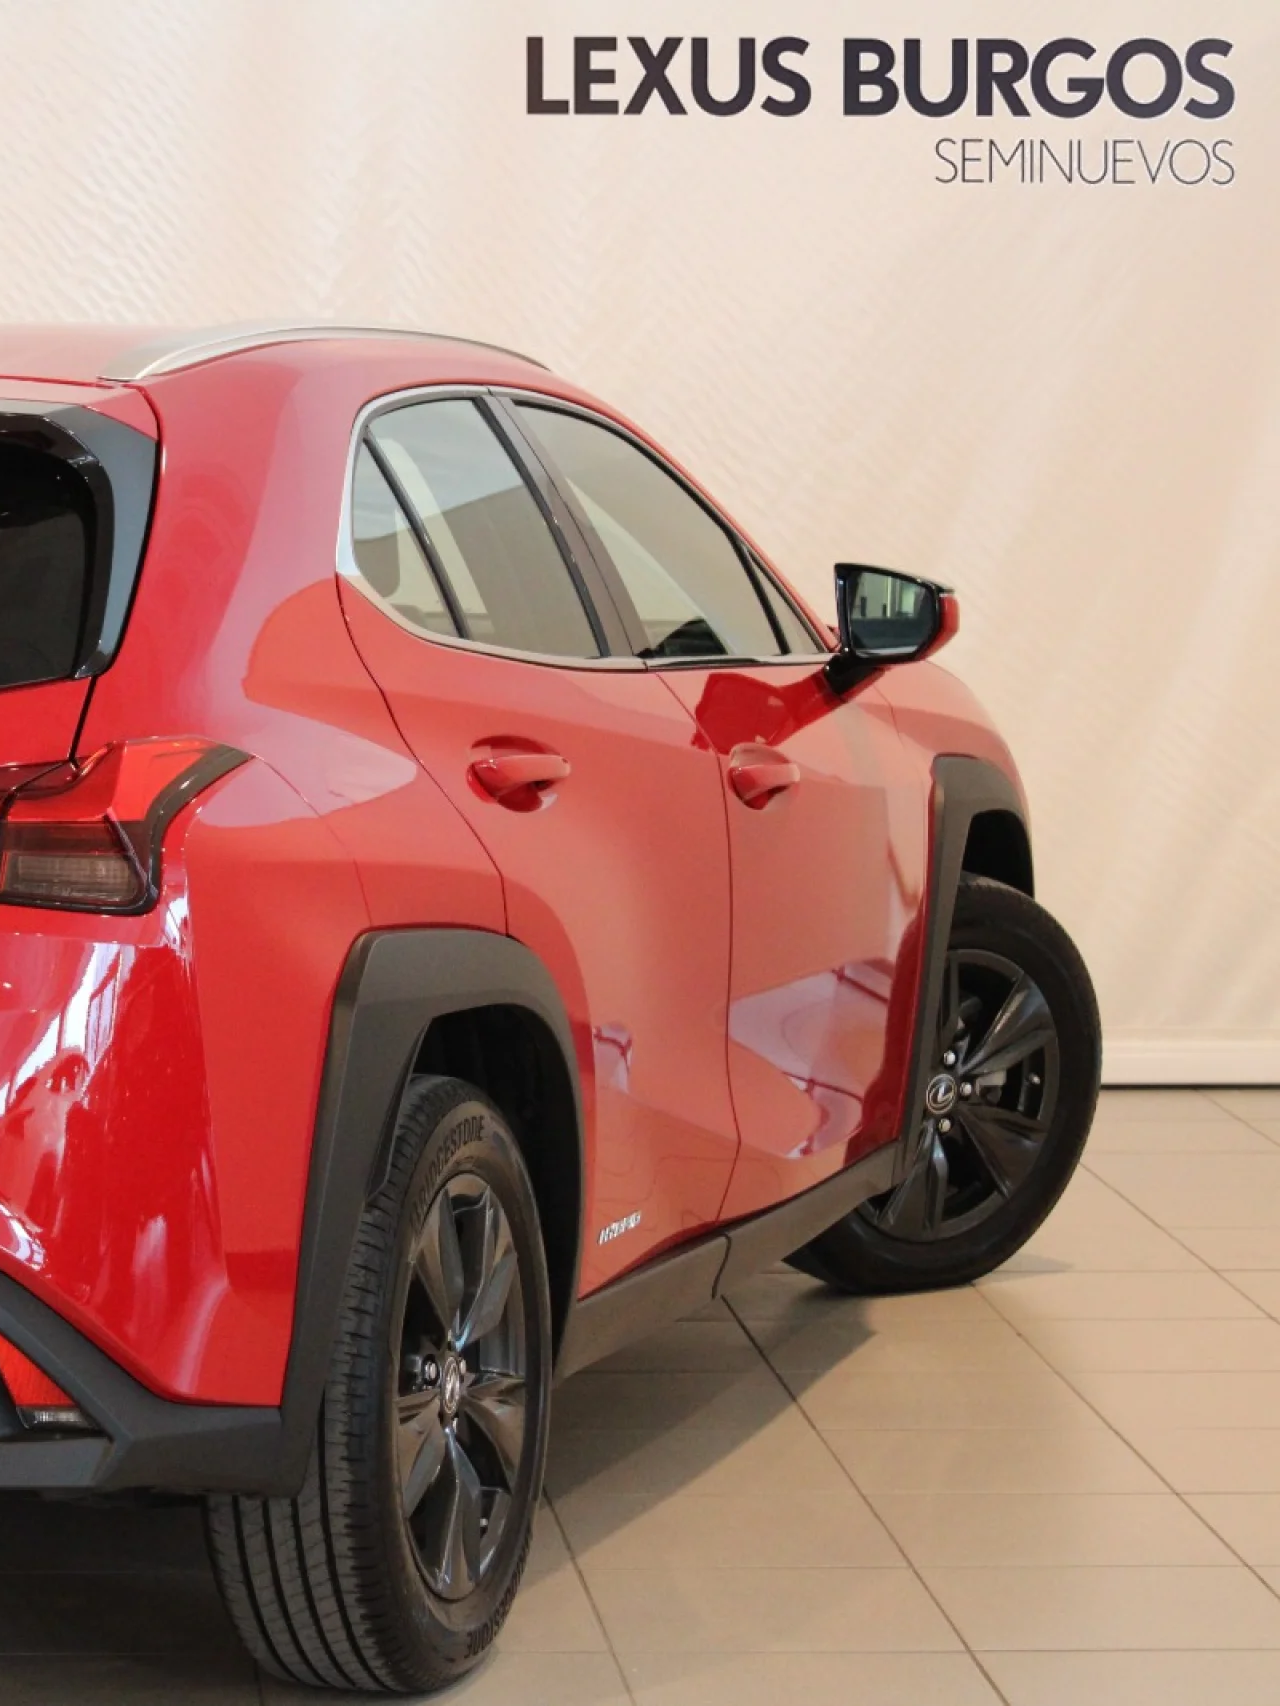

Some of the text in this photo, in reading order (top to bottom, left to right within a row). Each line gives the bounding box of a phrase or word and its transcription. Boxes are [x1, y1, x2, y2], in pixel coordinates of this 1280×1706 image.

[524, 35, 1236, 120] LEXUS BURGOS
[934, 137, 1236, 186] SEMINUEVOS
